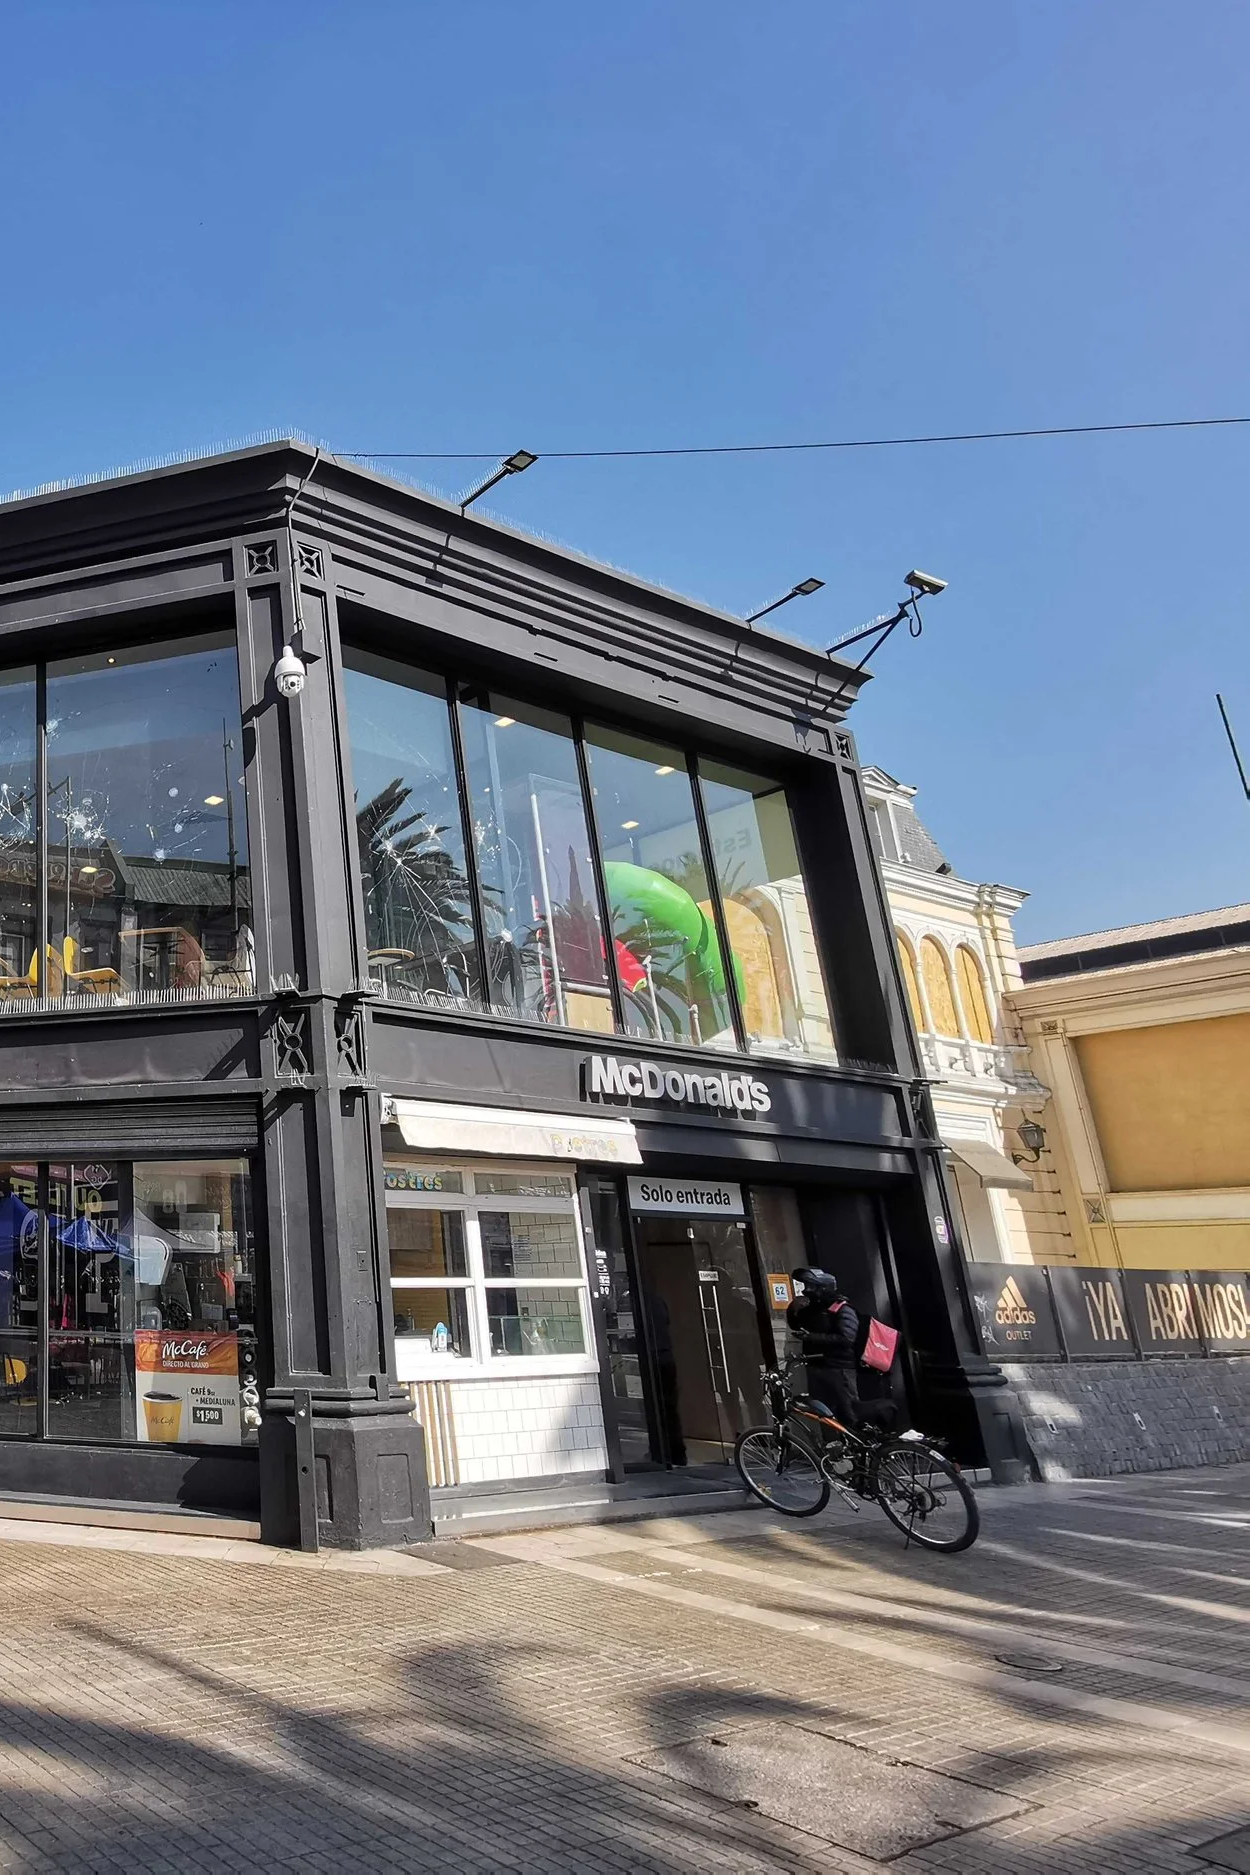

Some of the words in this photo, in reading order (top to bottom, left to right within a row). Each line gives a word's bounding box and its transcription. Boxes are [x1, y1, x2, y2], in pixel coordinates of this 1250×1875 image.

[592, 1056, 771, 1112] McDonald's
[383, 1170, 443, 1190] ostres
[640, 1184, 673, 1203] Solo
[677, 1188, 731, 1206] entrada
[775, 1286, 786, 1296] 62
[995, 1306, 1036, 1325] adidas
[1005, 1330, 1033, 1341] OUTLET
[161, 1339, 207, 1360] McCafé
[162, 1360, 184, 1368] DIRECTO
[190, 1386, 206, 1396] CAFÉ
[200, 1397, 235, 1406] MEDIALUNA
